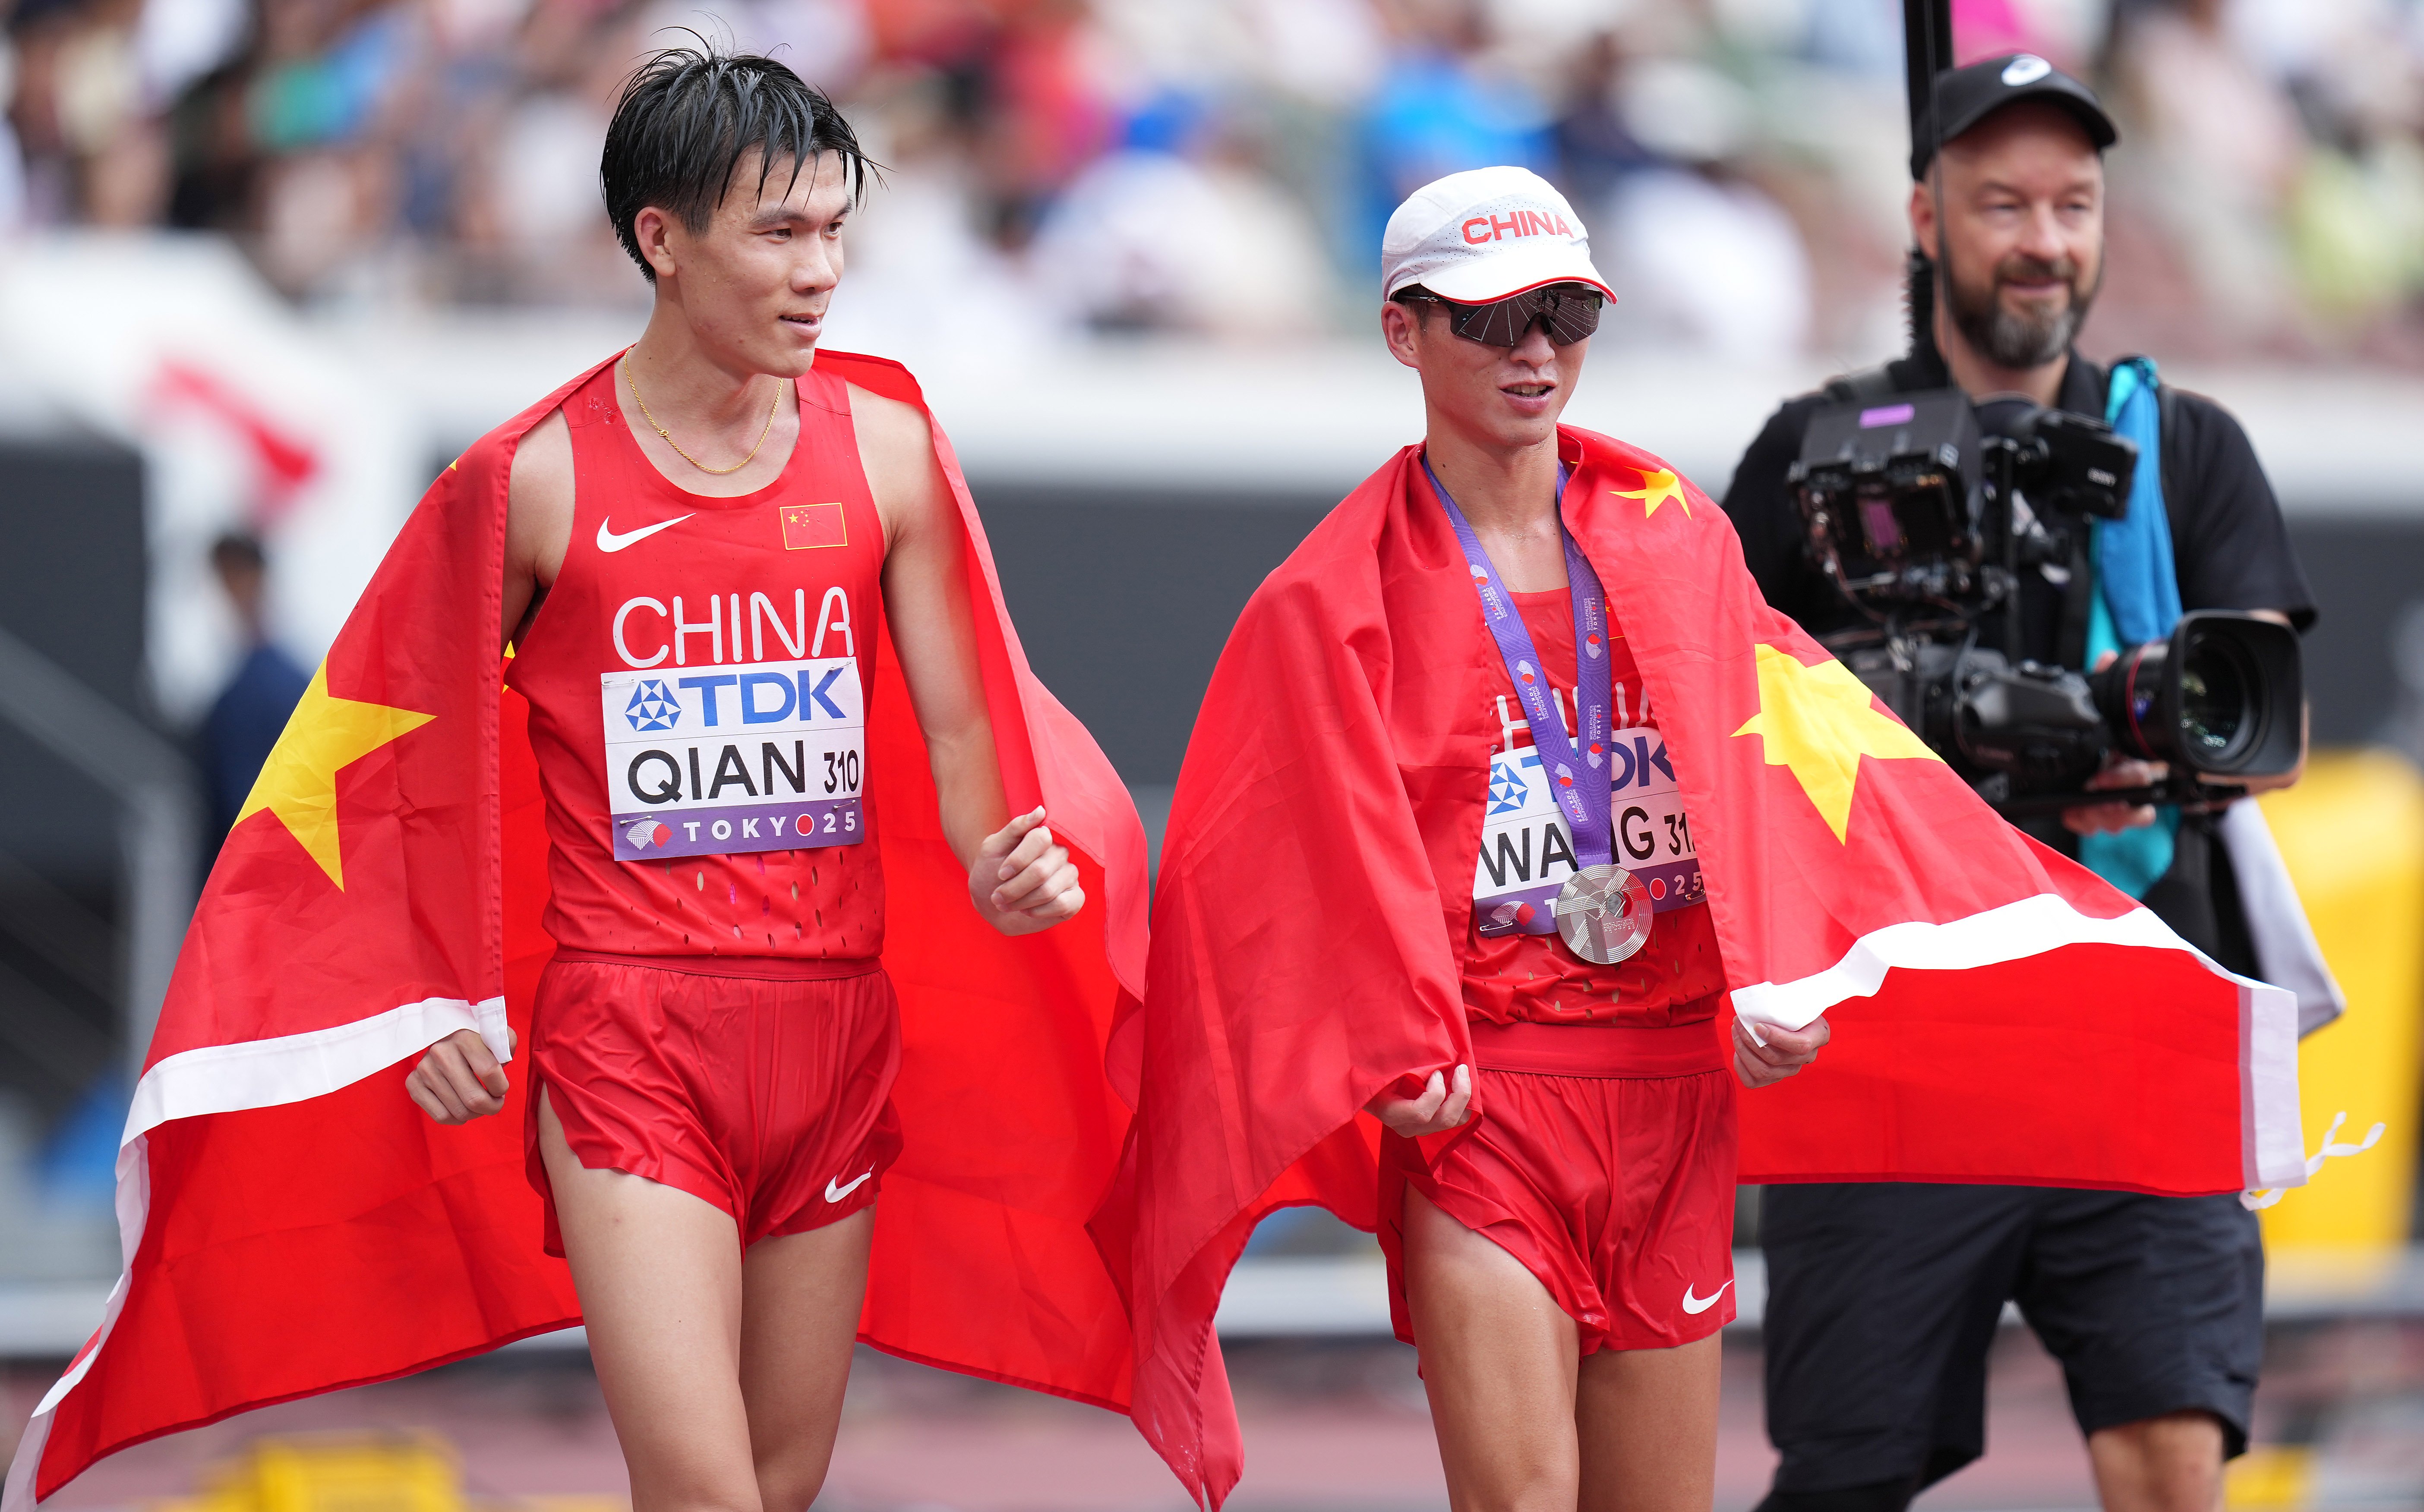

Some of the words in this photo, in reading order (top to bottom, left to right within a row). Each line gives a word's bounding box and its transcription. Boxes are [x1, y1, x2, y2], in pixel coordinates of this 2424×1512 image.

[1462, 211, 1574, 245] CHINA
[1486, 587, 1504, 618] CHAMPIONSHIPS
[1490, 586, 1498, 599] WORLD
[1496, 598, 1508, 617] ATHLETICS
[613, 586, 855, 668] CHINA
[679, 668, 846, 727] TDK
[1531, 687, 1546, 719] CHAMPIONSHIPS
[1540, 699, 1549, 719] ATHLETICS
[628, 740, 806, 804] QIAN
[824, 750, 859, 794] 310
[1569, 790, 1585, 822] CHAMPIONSHIPS
[1578, 802, 1588, 821] ATHLETICS
[1480, 806, 1656, 887] WAG
[1664, 813, 1695, 856] 31
